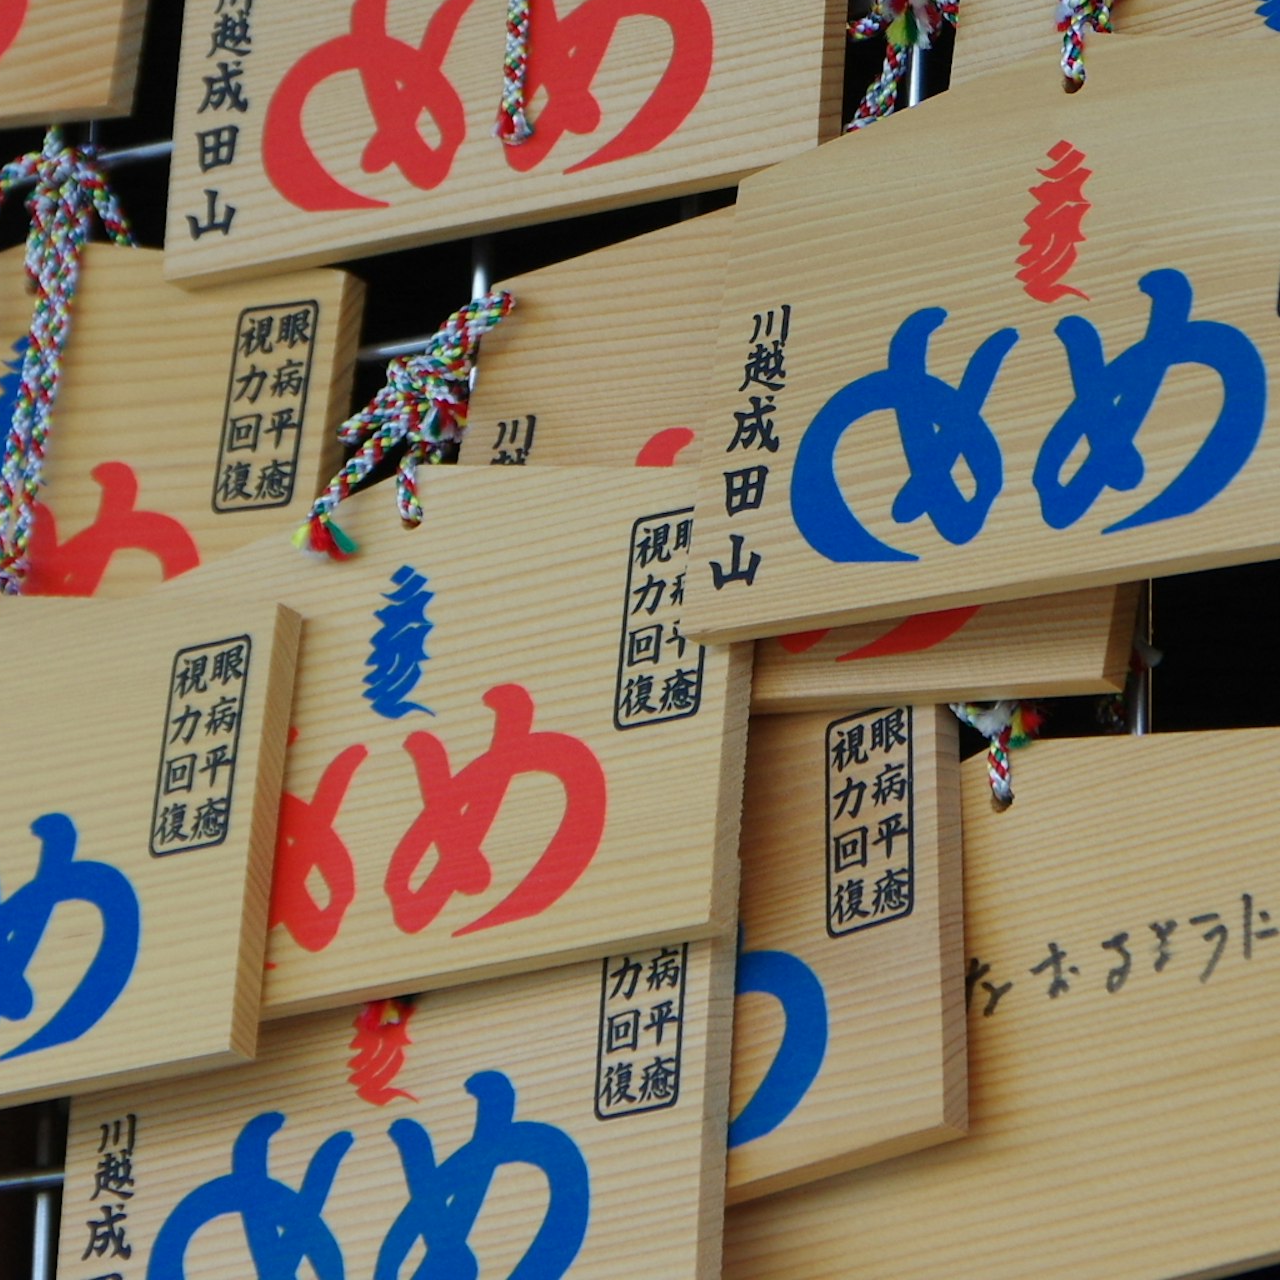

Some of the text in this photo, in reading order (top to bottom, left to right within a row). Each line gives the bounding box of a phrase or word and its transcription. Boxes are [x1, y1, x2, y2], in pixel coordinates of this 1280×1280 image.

[219, 317, 276, 502] 視力回復
[253, 309, 311, 501] 眼病平癒
[709, 304, 791, 591] 川越成田山
[790, 269, 1267, 563] めめ
[620, 523, 671, 715] 視力回復
[154, 658, 208, 846] 視力回復
[187, 642, 245, 842] 眼病平癒
[831, 729, 869, 923] 視力回復
[870, 708, 912, 914] 眼病平癒
[601, 958, 646, 1104] 力回復
[634, 948, 683, 1102] 病平癒
[82, 1114, 137, 1280] 川越成
